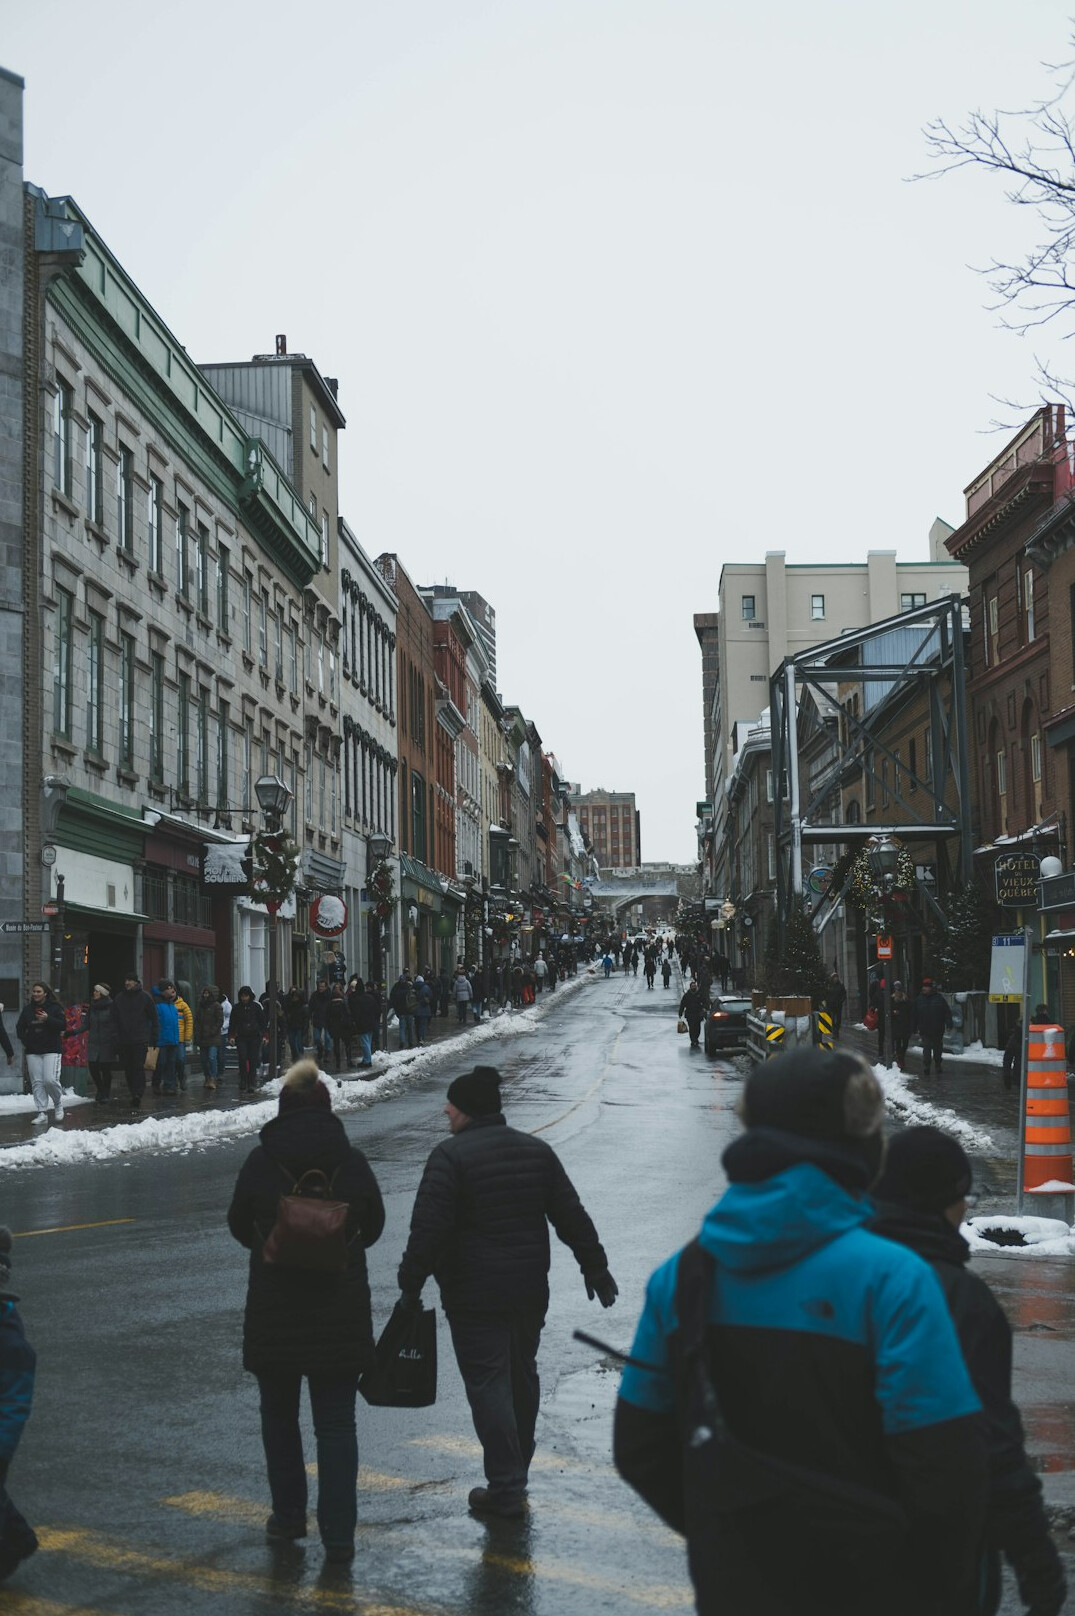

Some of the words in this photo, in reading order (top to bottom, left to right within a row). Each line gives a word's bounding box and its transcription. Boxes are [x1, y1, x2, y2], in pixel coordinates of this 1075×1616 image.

[204, 874, 248, 883] SOULIERS
[1002, 877, 1034, 887] VIEUX
[1003, 937, 1010, 946] 11
